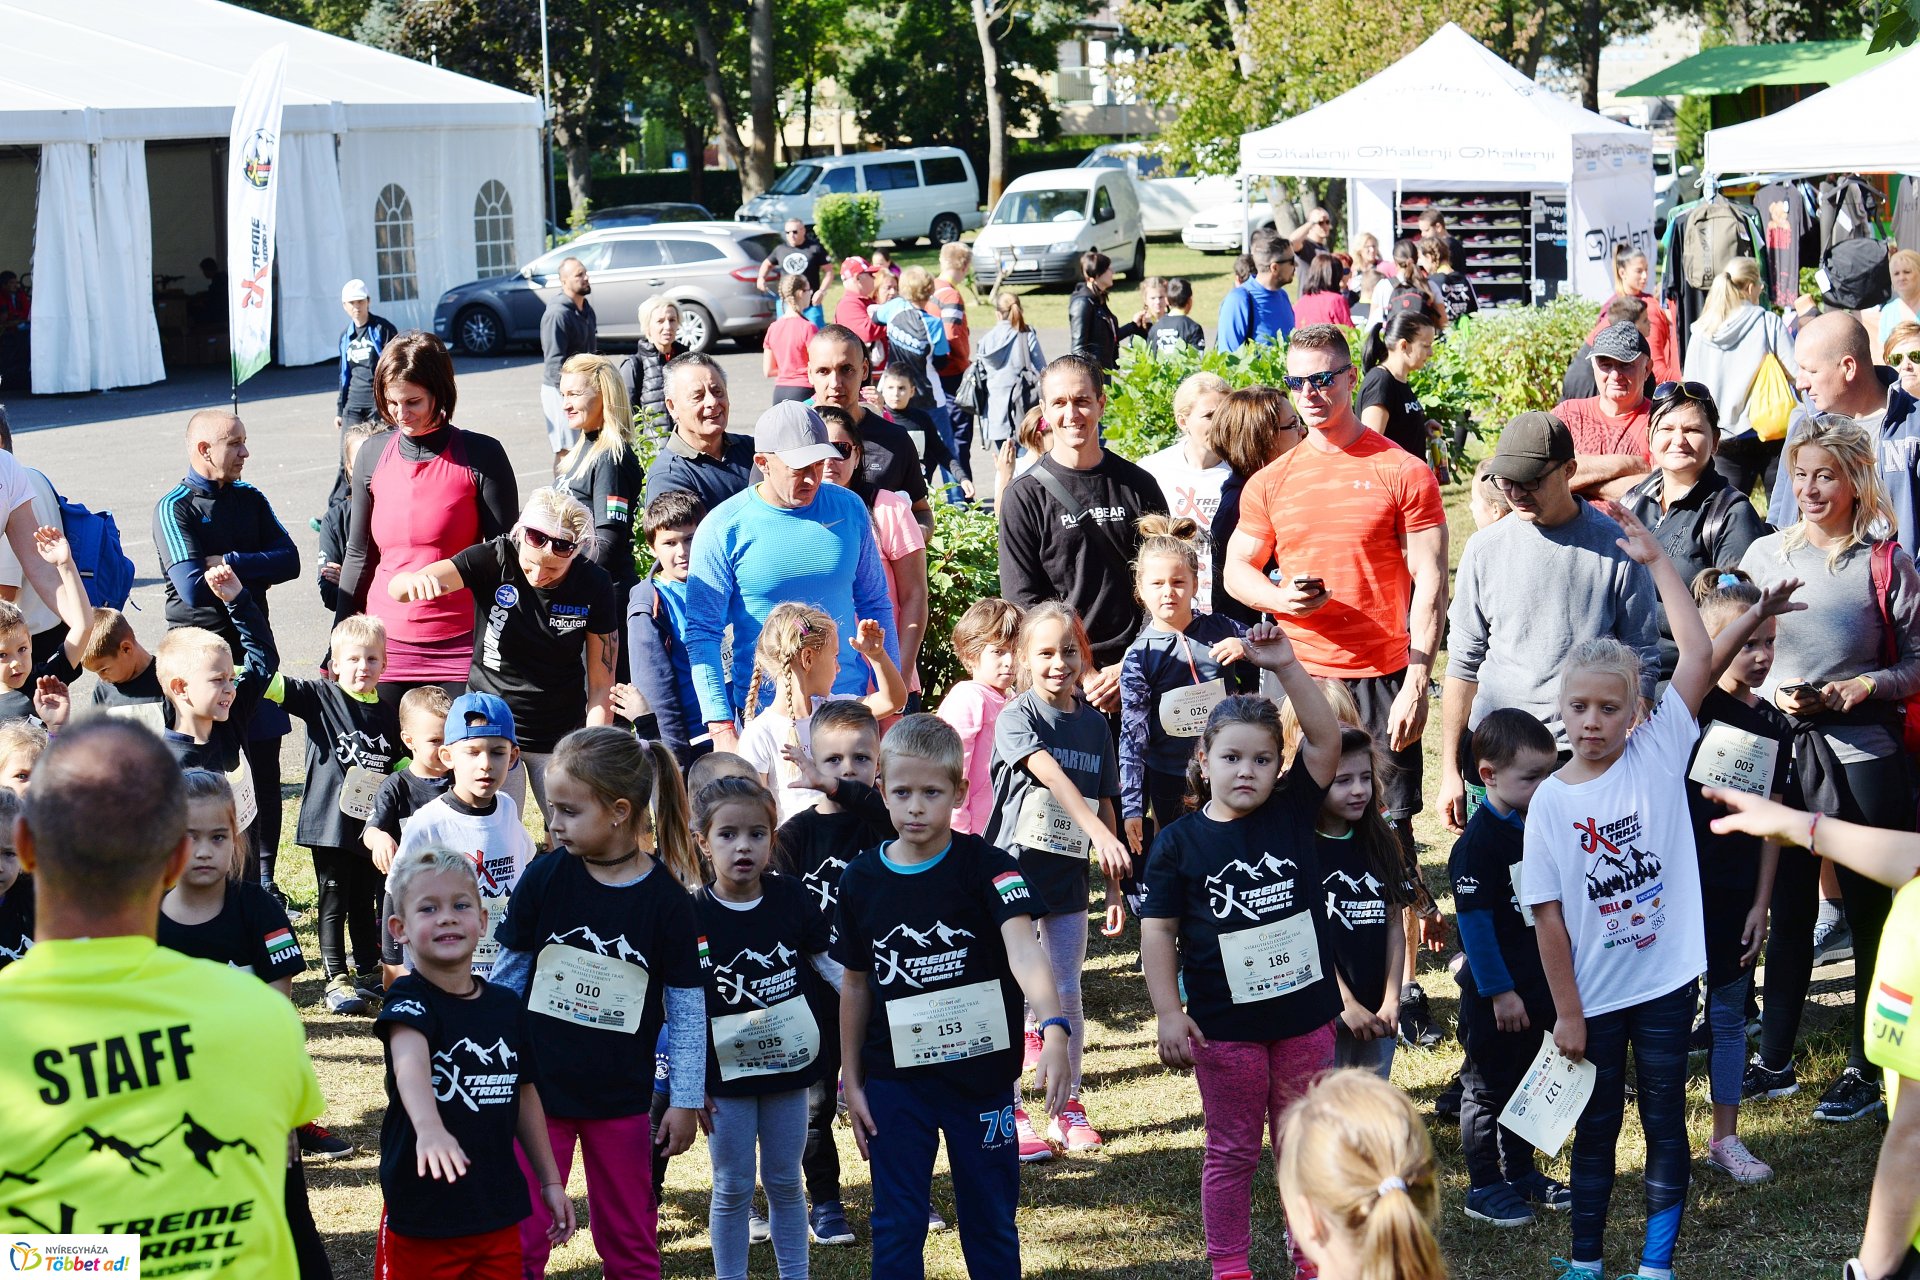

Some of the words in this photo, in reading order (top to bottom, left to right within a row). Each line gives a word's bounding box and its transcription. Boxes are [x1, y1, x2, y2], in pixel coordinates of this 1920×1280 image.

[606, 510, 629, 523] HUN
[1060, 506, 1126, 526] PU&BEAR
[551, 604, 588, 616] SUPER
[549, 617, 587, 629] Rakuten
[1190, 705, 1208, 717] 026
[1734, 759, 1754, 773] 003
[1053, 818, 1072, 831] 083
[1608, 822, 1642, 843] TRAIL
[491, 866, 516, 877] TRAIL
[1001, 887, 1031, 904] HUN
[1246, 892, 1294, 909] TRAIL
[1345, 909, 1386, 918] TRAIL
[1598, 901, 1622, 915] HELL
[1616, 933, 1642, 946] AXIÁL
[270, 945, 302, 965] HUN
[1268, 952, 1290, 968] 186
[911, 960, 966, 977] TRAIL
[921, 972, 953, 984] HUNGARY
[575, 982, 601, 998] 010
[756, 977, 798, 998] TRAIL
[937, 1021, 963, 1037] 153
[758, 1036, 782, 1050] 035
[33, 1024, 195, 1106] STAFF
[469, 1085, 514, 1096] TRAIL
[1544, 1080, 1562, 1105] 127
[979, 1105, 1016, 1143] 76
